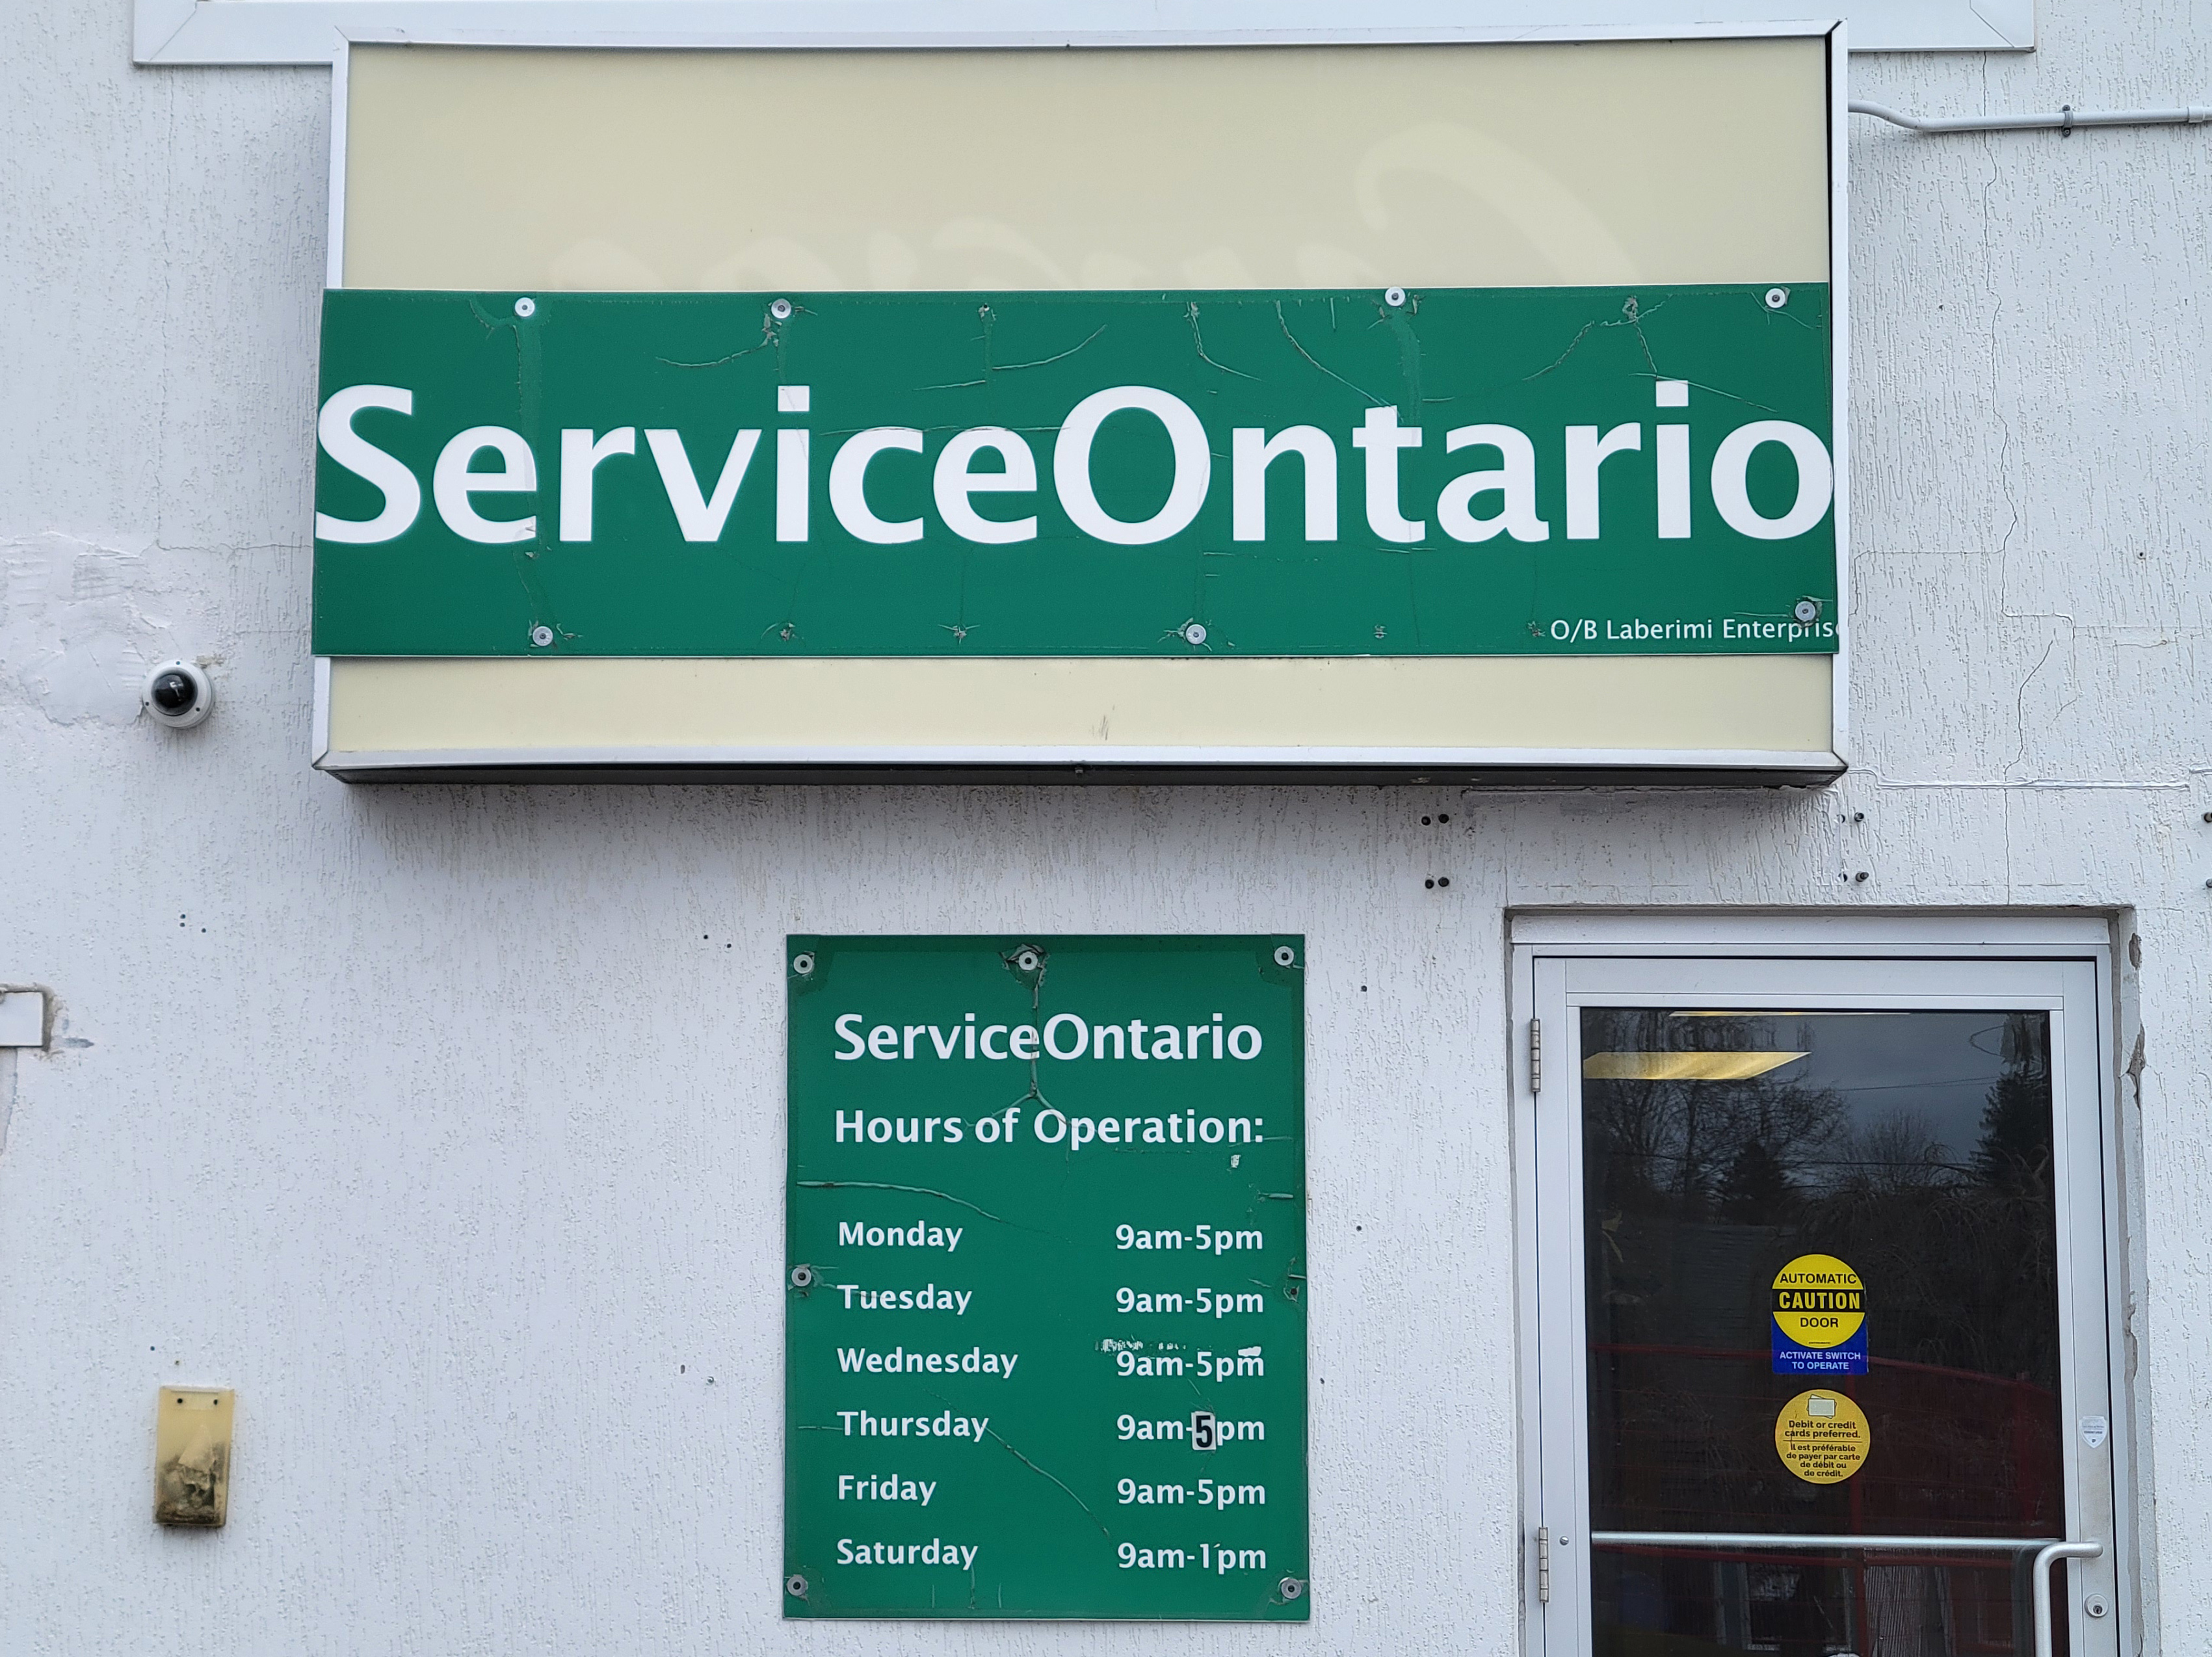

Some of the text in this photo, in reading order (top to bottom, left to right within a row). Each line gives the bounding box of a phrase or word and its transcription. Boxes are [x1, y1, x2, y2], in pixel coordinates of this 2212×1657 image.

[314, 378, 1834, 546] ServiceOntario
[1550, 618, 1839, 643] O/B Laberimi Enterpris
[834, 1013, 1263, 1061] ServiceOntario
[836, 1107, 1264, 1152] Hours of Operation:
[837, 1220, 1264, 1256] Monday 9am-5pm
[1780, 1273, 1857, 1284] AUTOMATIC
[836, 1283, 1265, 1319] Tuesday 9am-5pm
[1779, 1292, 1860, 1309] CAUTION
[1800, 1317, 1839, 1328] DOOR
[836, 1346, 1265, 1383] Wednesday 9am-5pm
[1779, 1351, 1861, 1360] ACTIVATE SWITCH
[1791, 1361, 1804, 1370] TO
[836, 1410, 1265, 1448] Thursday 9am-5pm
[1812, 1430, 1861, 1439] preferred.
[1812, 1444, 1856, 1452] préférable
[837, 1473, 1267, 1511] Friday 9am-5pm
[836, 1537, 1267, 1576] Saturday 9am-1pm
